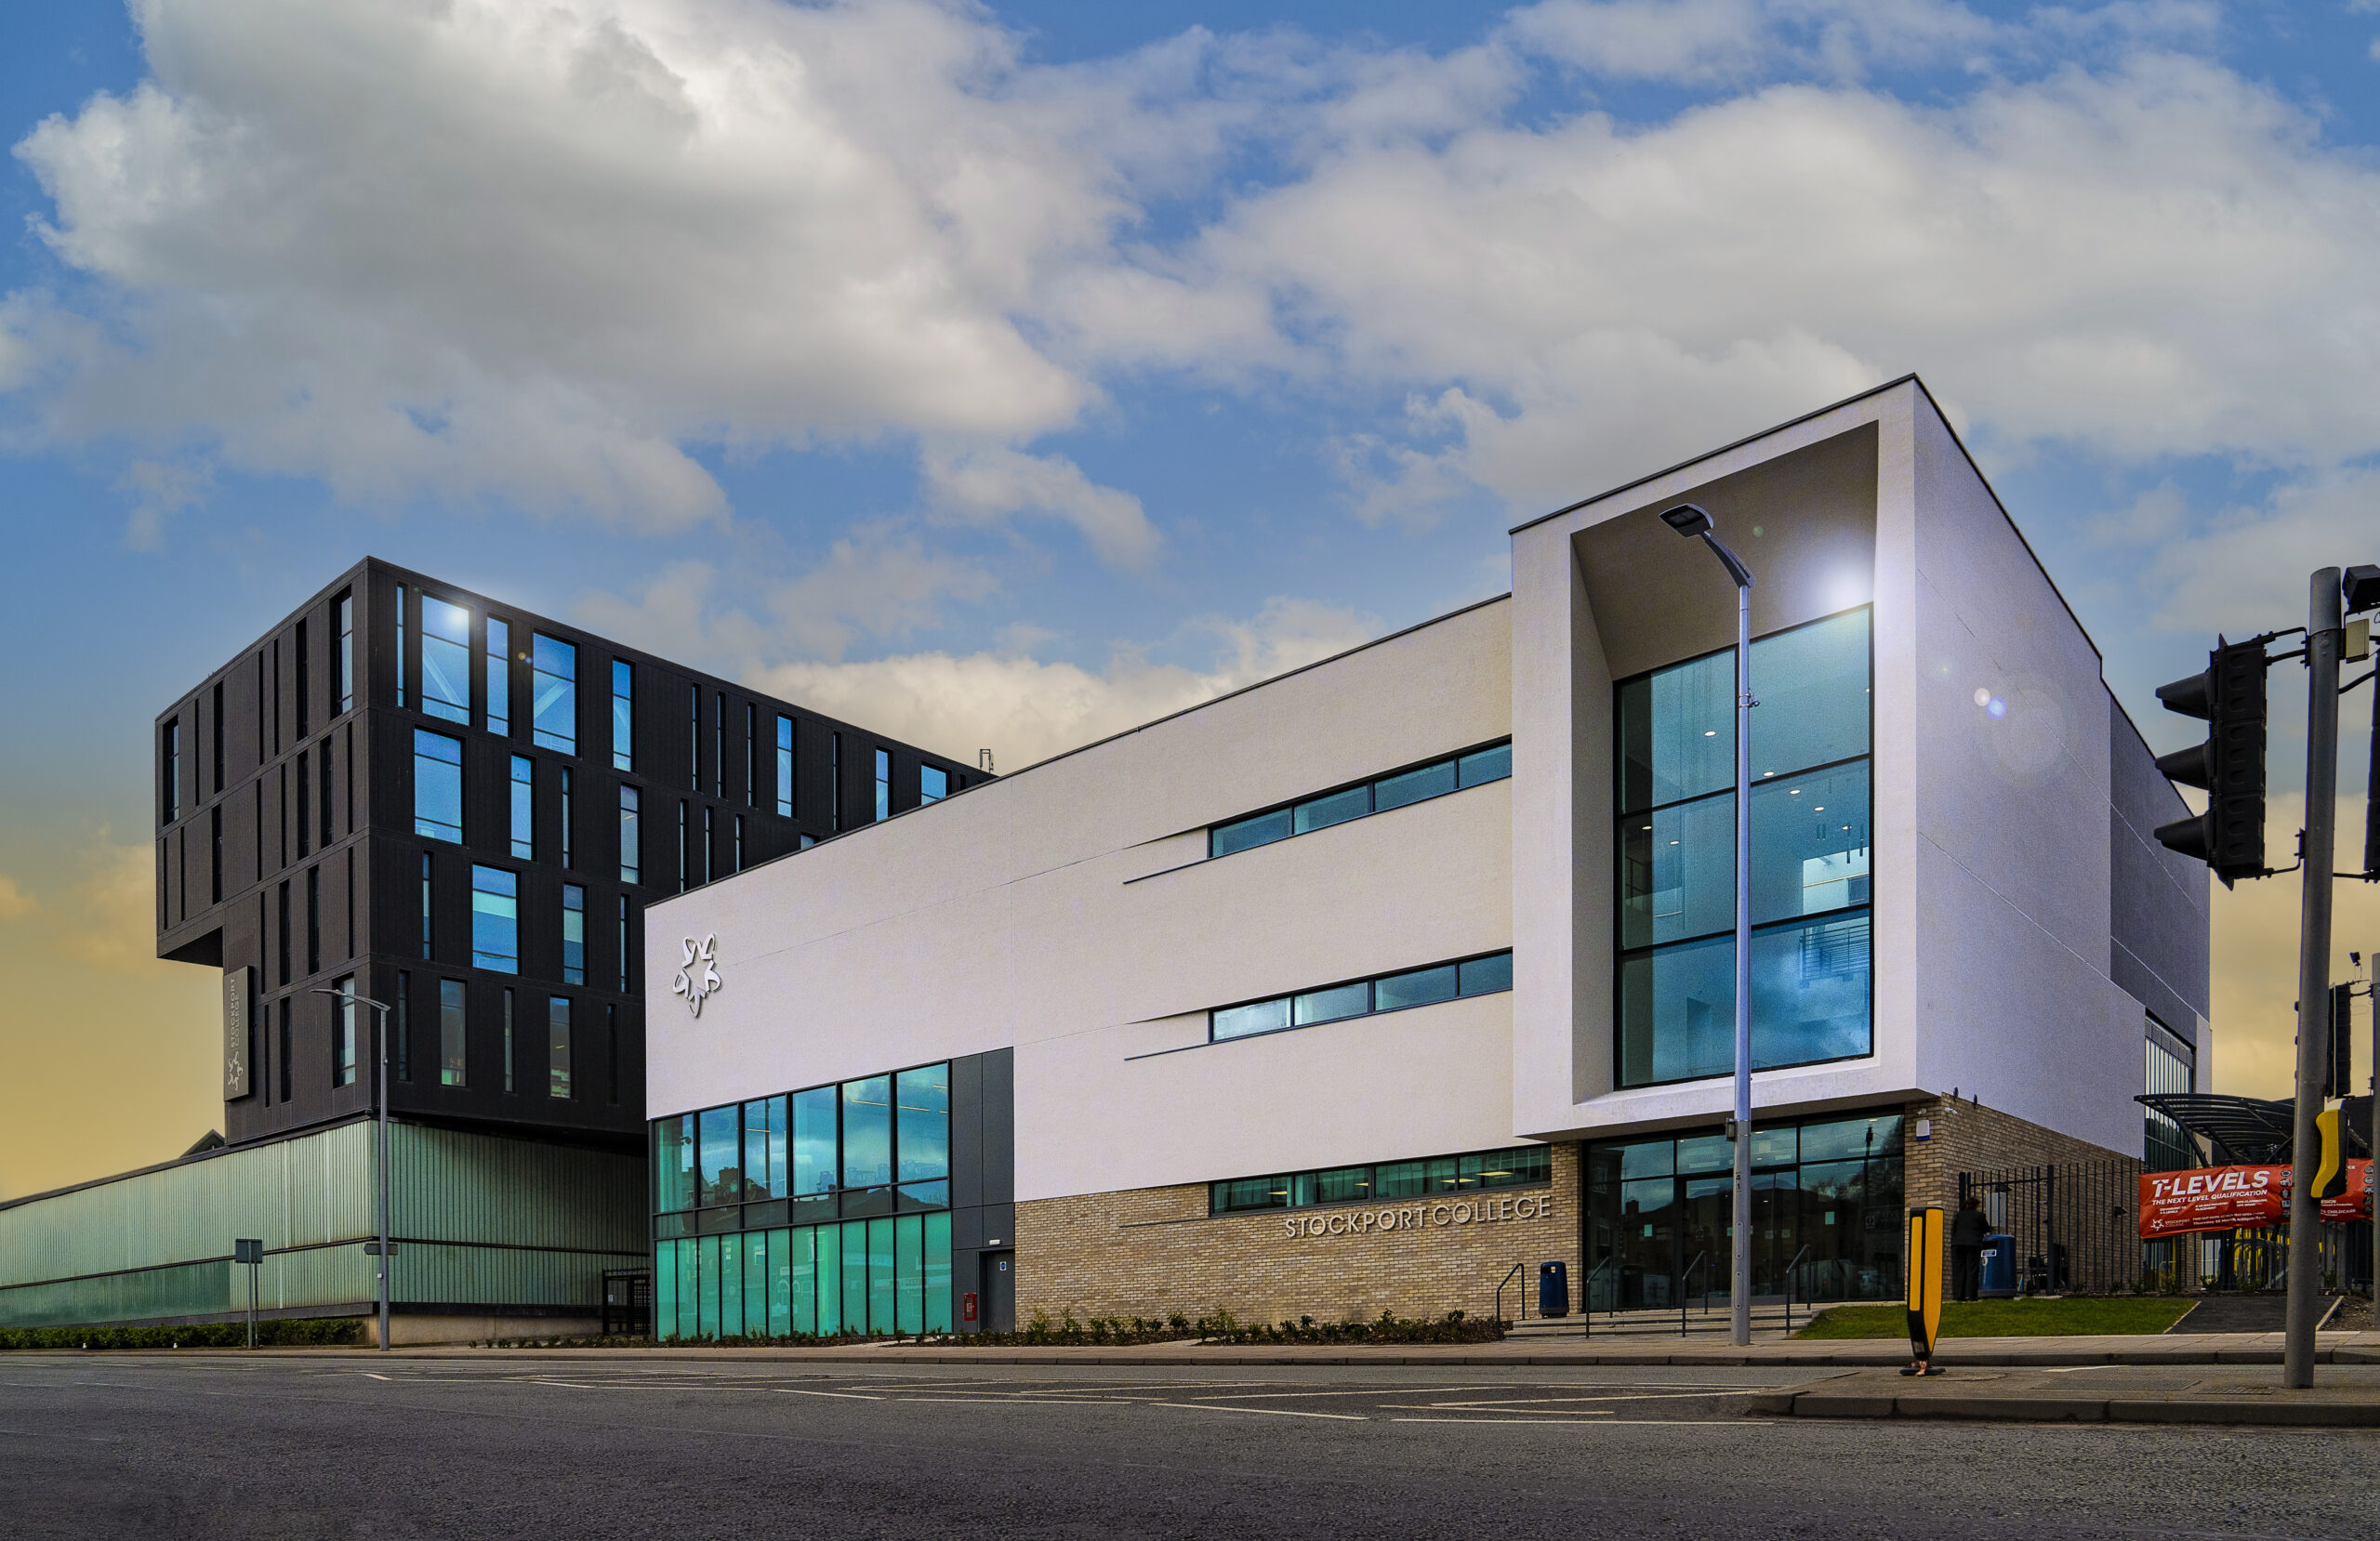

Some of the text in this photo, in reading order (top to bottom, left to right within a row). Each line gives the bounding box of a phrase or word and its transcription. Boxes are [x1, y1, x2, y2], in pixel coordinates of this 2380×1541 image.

[2152, 1170, 2270, 1197] T-LEVELS
[2211, 1190, 2268, 1199] QUALIFICATION
[1285, 1195, 1552, 1238] STOCKPORT COLLEGE
